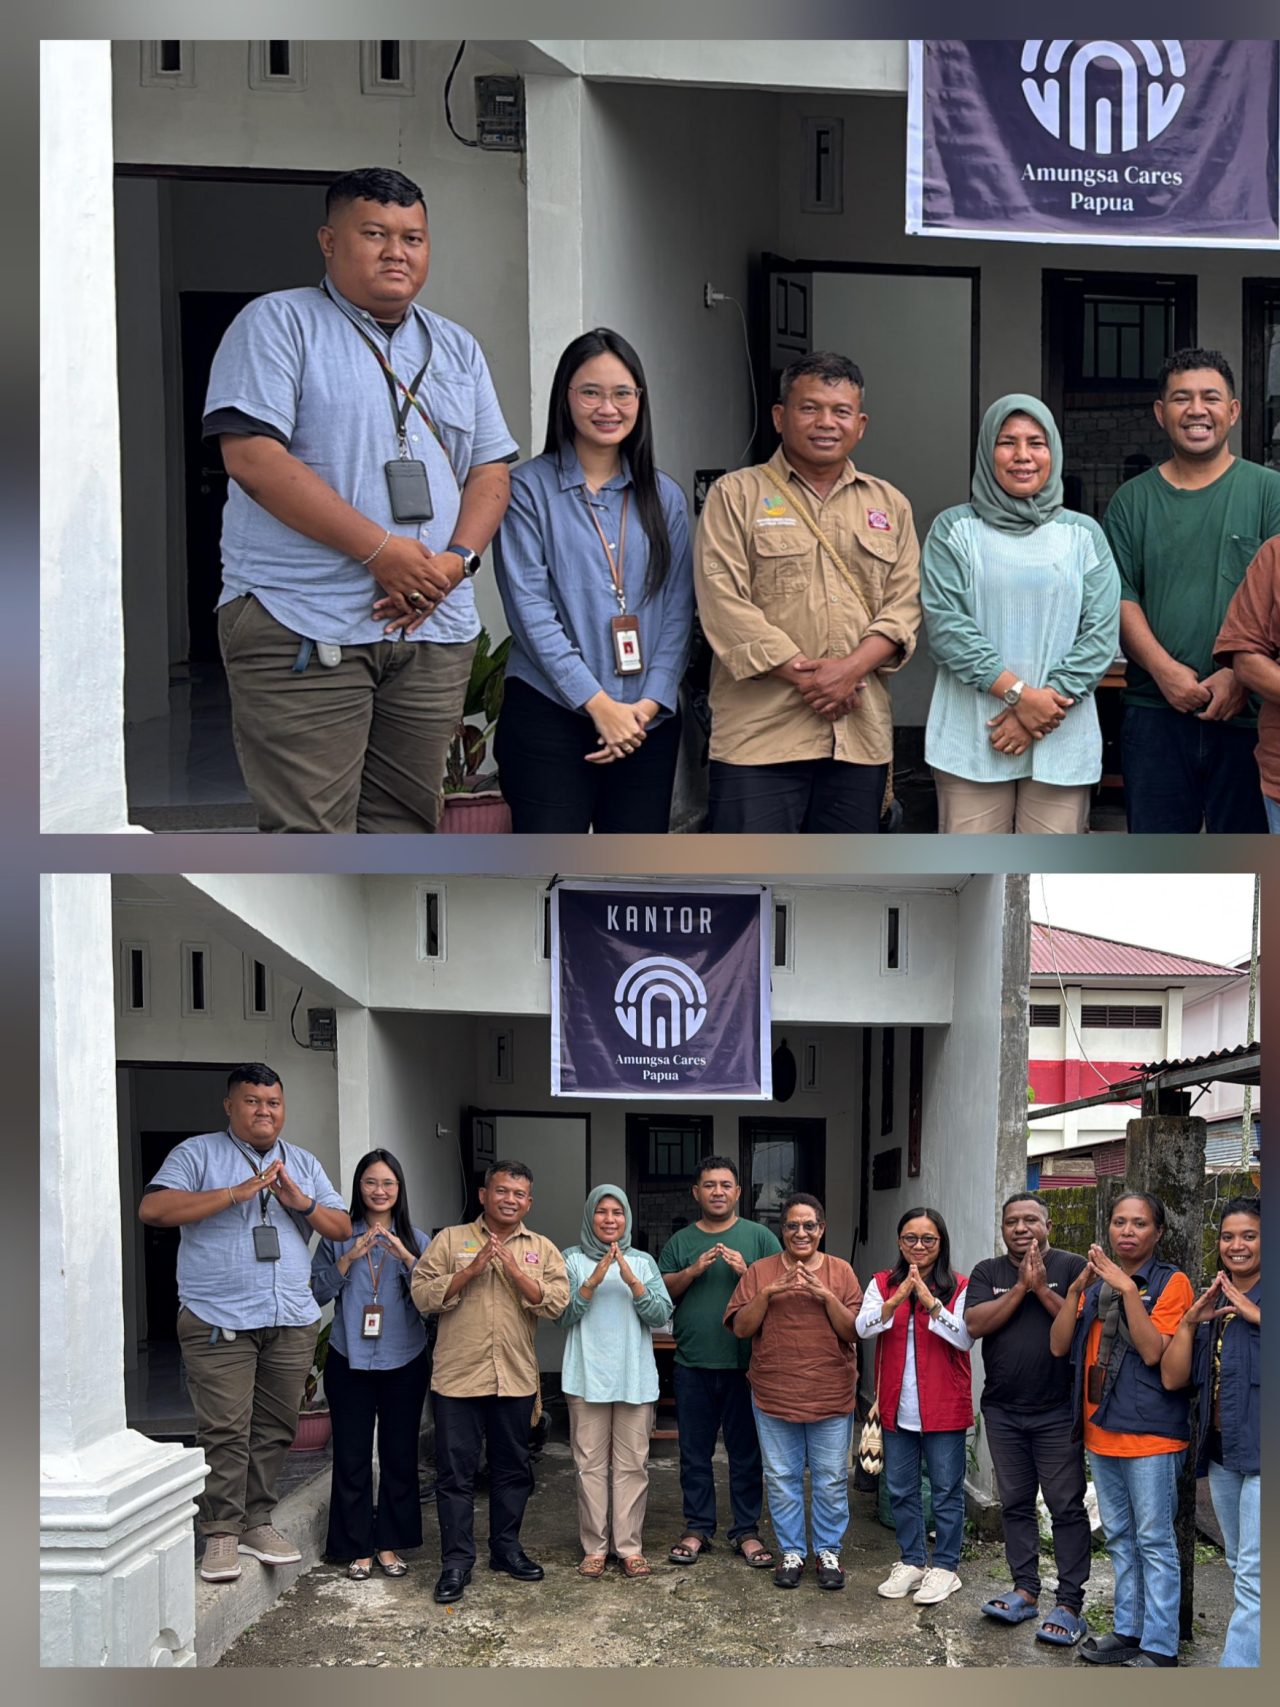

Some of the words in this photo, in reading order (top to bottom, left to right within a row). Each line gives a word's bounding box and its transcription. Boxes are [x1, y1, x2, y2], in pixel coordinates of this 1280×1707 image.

[1022, 163, 1118, 186] Amungsa
[1124, 166, 1183, 186] Cares
[1070, 192, 1134, 215] Papua
[608, 905, 712, 933] KANTOR
[615, 1054, 670, 1067] Amungsa
[673, 1055, 706, 1066] Cares
[643, 1070, 679, 1082] Papua
